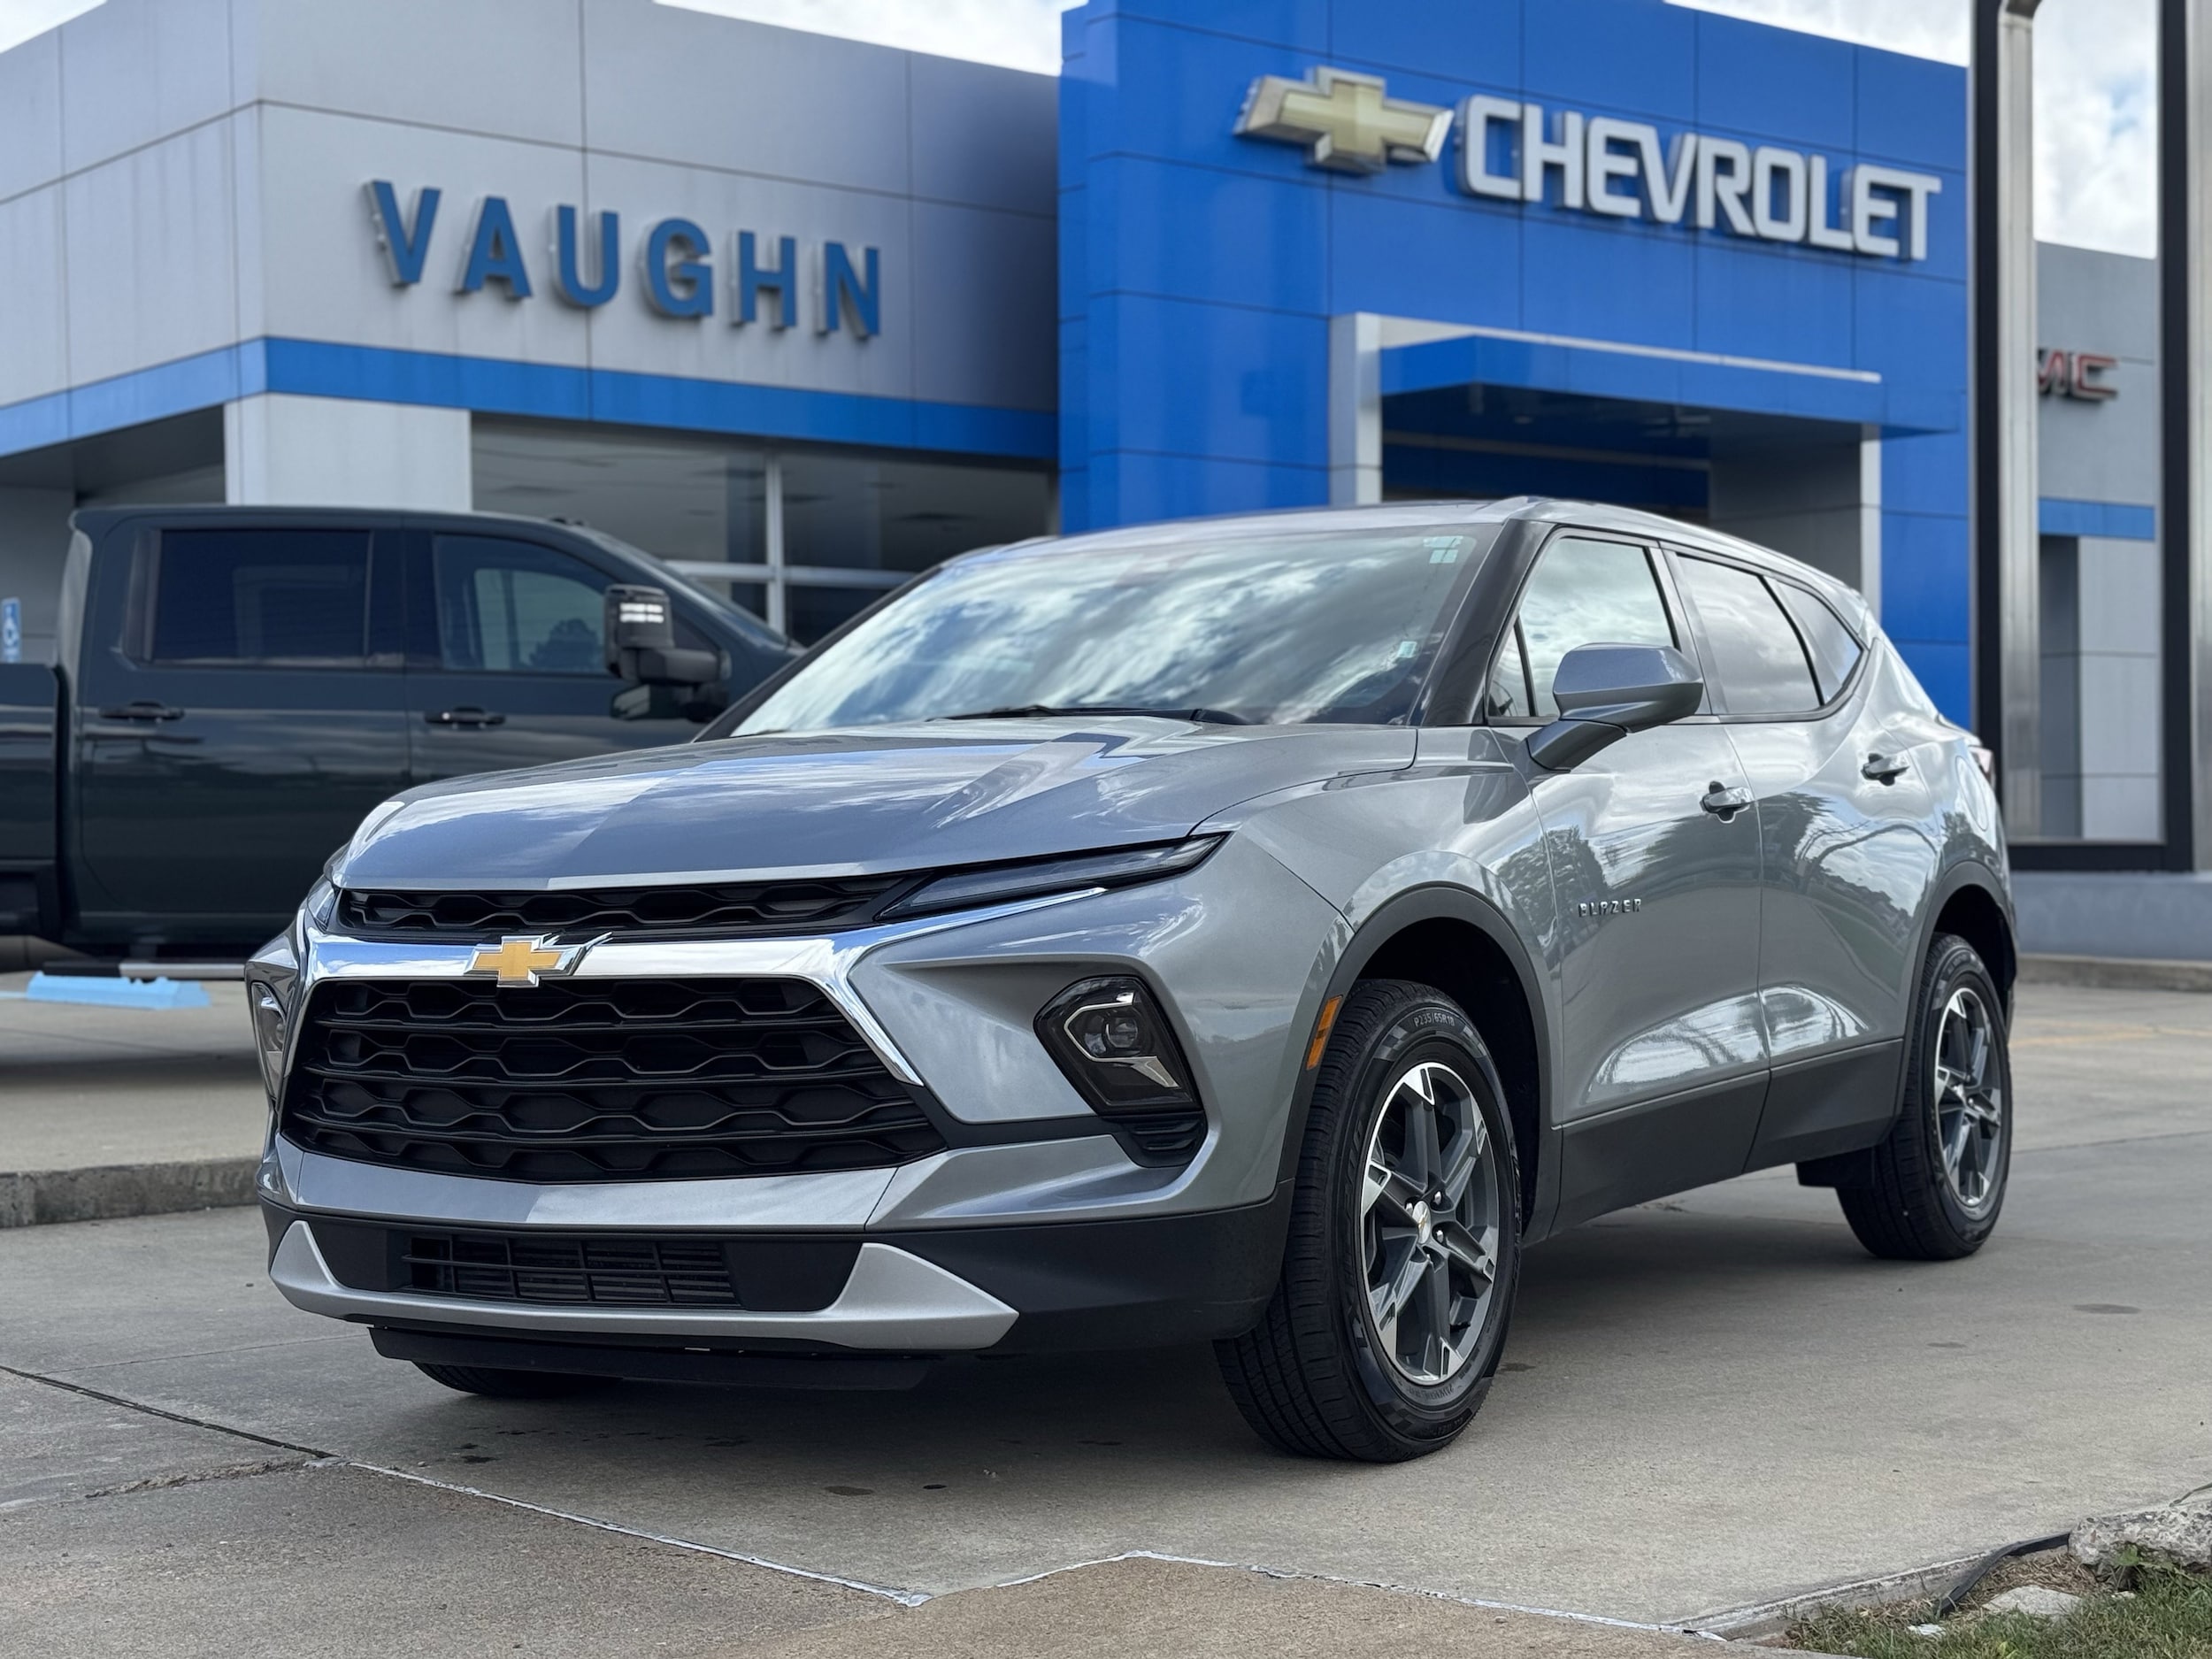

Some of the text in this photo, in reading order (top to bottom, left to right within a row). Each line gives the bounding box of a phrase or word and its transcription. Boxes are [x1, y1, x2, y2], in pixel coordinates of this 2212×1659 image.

[1456, 95, 1942, 261] CHEVROLET
[365, 180, 880, 338] VAUGHN
[2038, 349, 2119, 401] MC
[1578, 898, 1641, 918] BLAZER
[1413, 1012, 1455, 1027] P235/65R18
